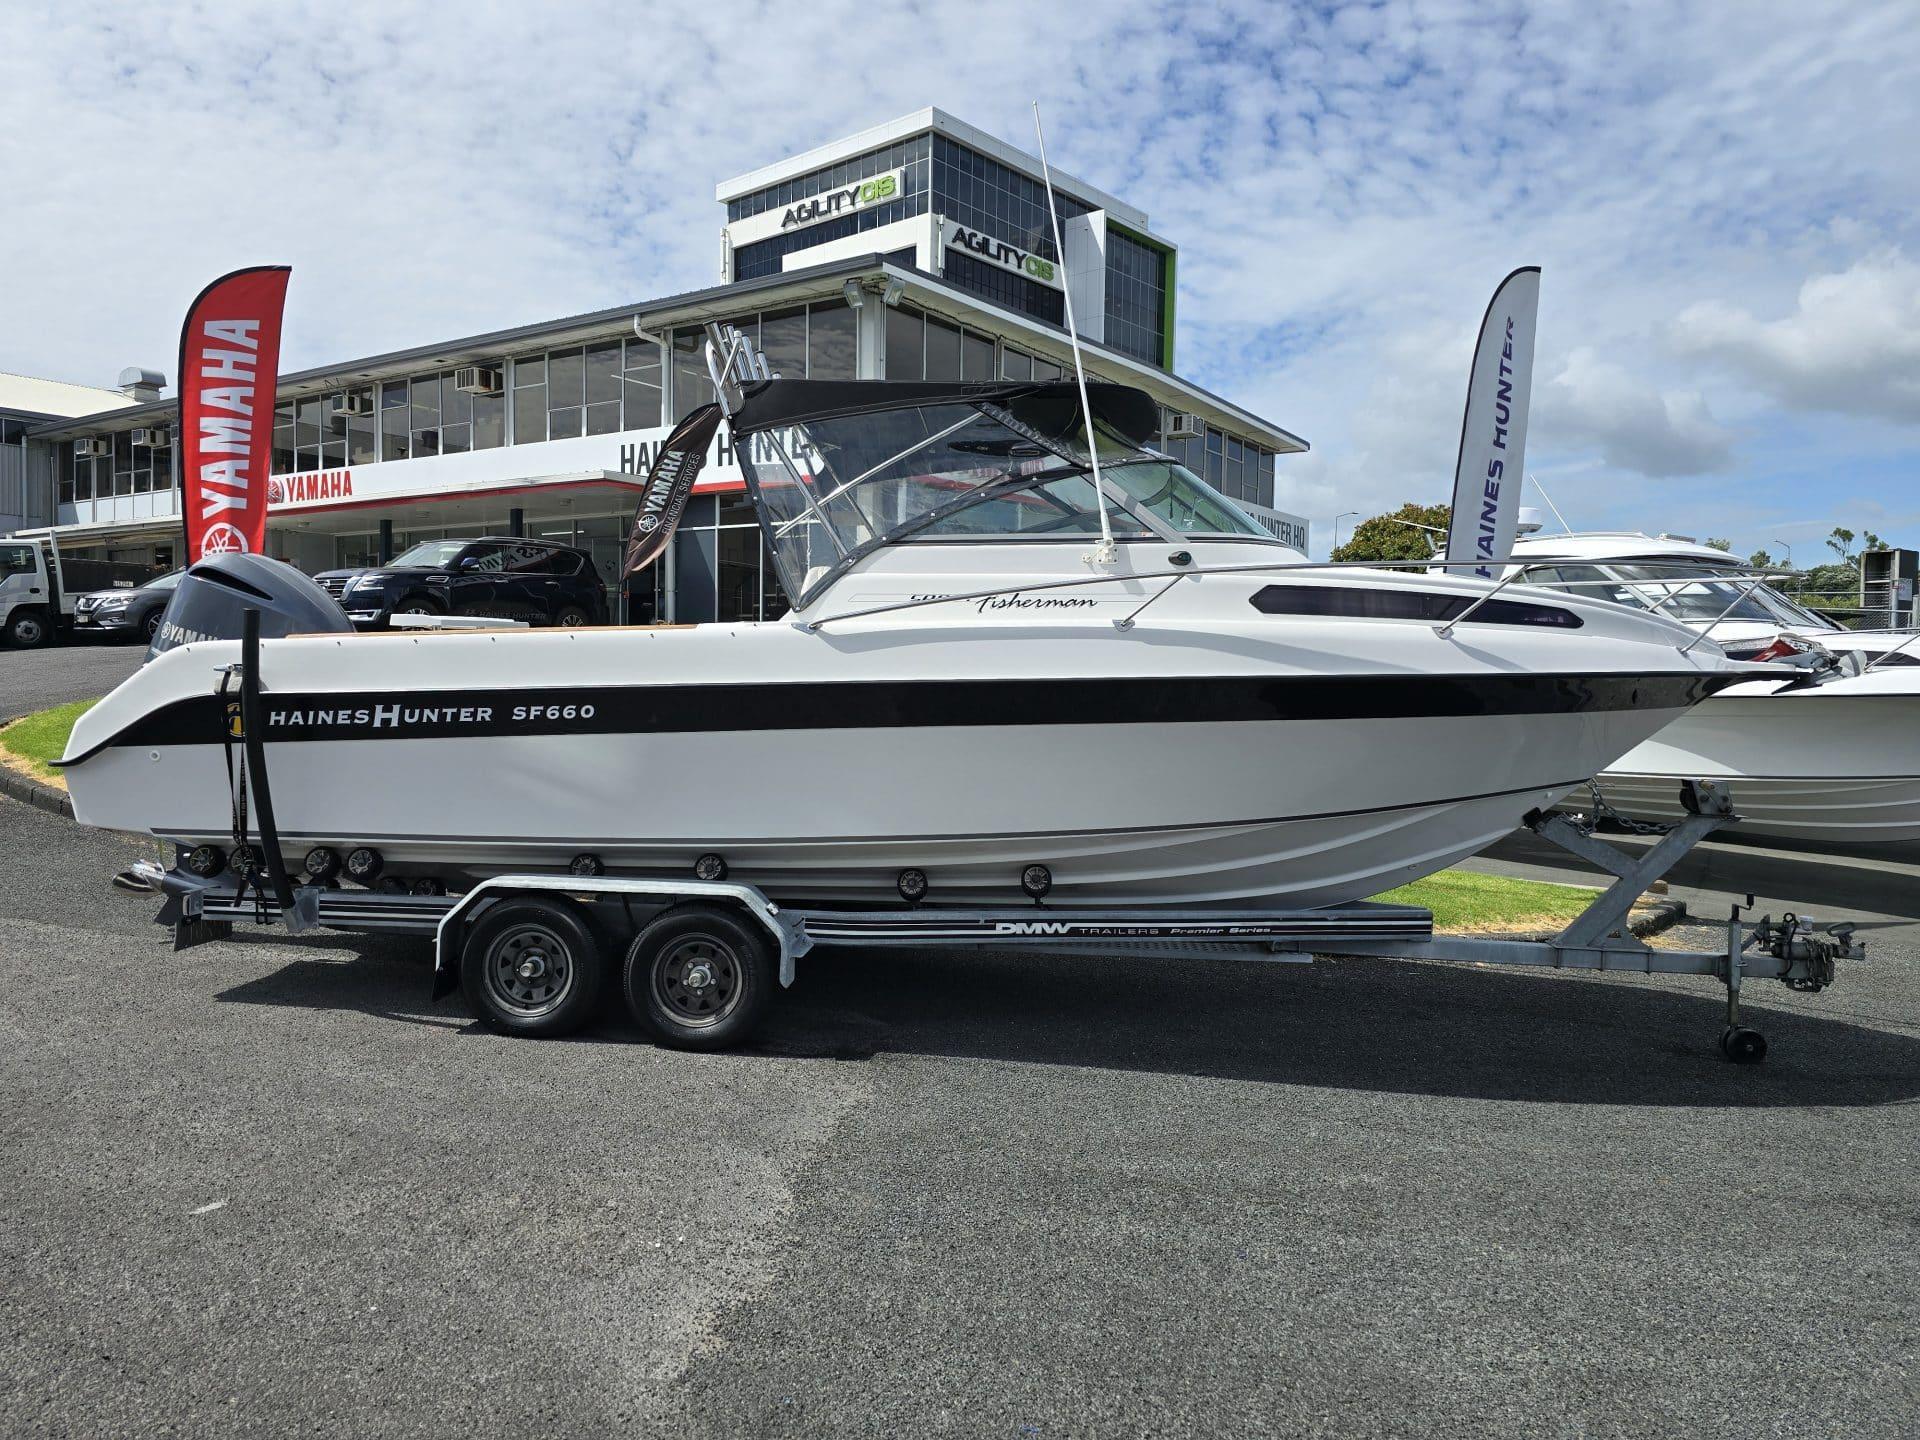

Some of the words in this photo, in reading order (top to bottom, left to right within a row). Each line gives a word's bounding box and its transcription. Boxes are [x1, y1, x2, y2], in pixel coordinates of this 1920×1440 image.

[200, 319, 260, 519] YAMAHA
[1475, 459, 1504, 578] HAINES
[1493, 316, 1514, 450] HUNTER
[286, 471, 352, 502] YAMAHA
[644, 450, 686, 512] YAMAHA
[661, 494, 686, 534] FINANCIAL
[679, 453, 700, 492] SERVICES
[1294, 524, 1305, 550] HQ
[975, 593, 1098, 615] Fisherman
[170, 624, 224, 643] YAMA
[512, 705, 595, 720] SF660
[996, 922, 1071, 934] DMW
